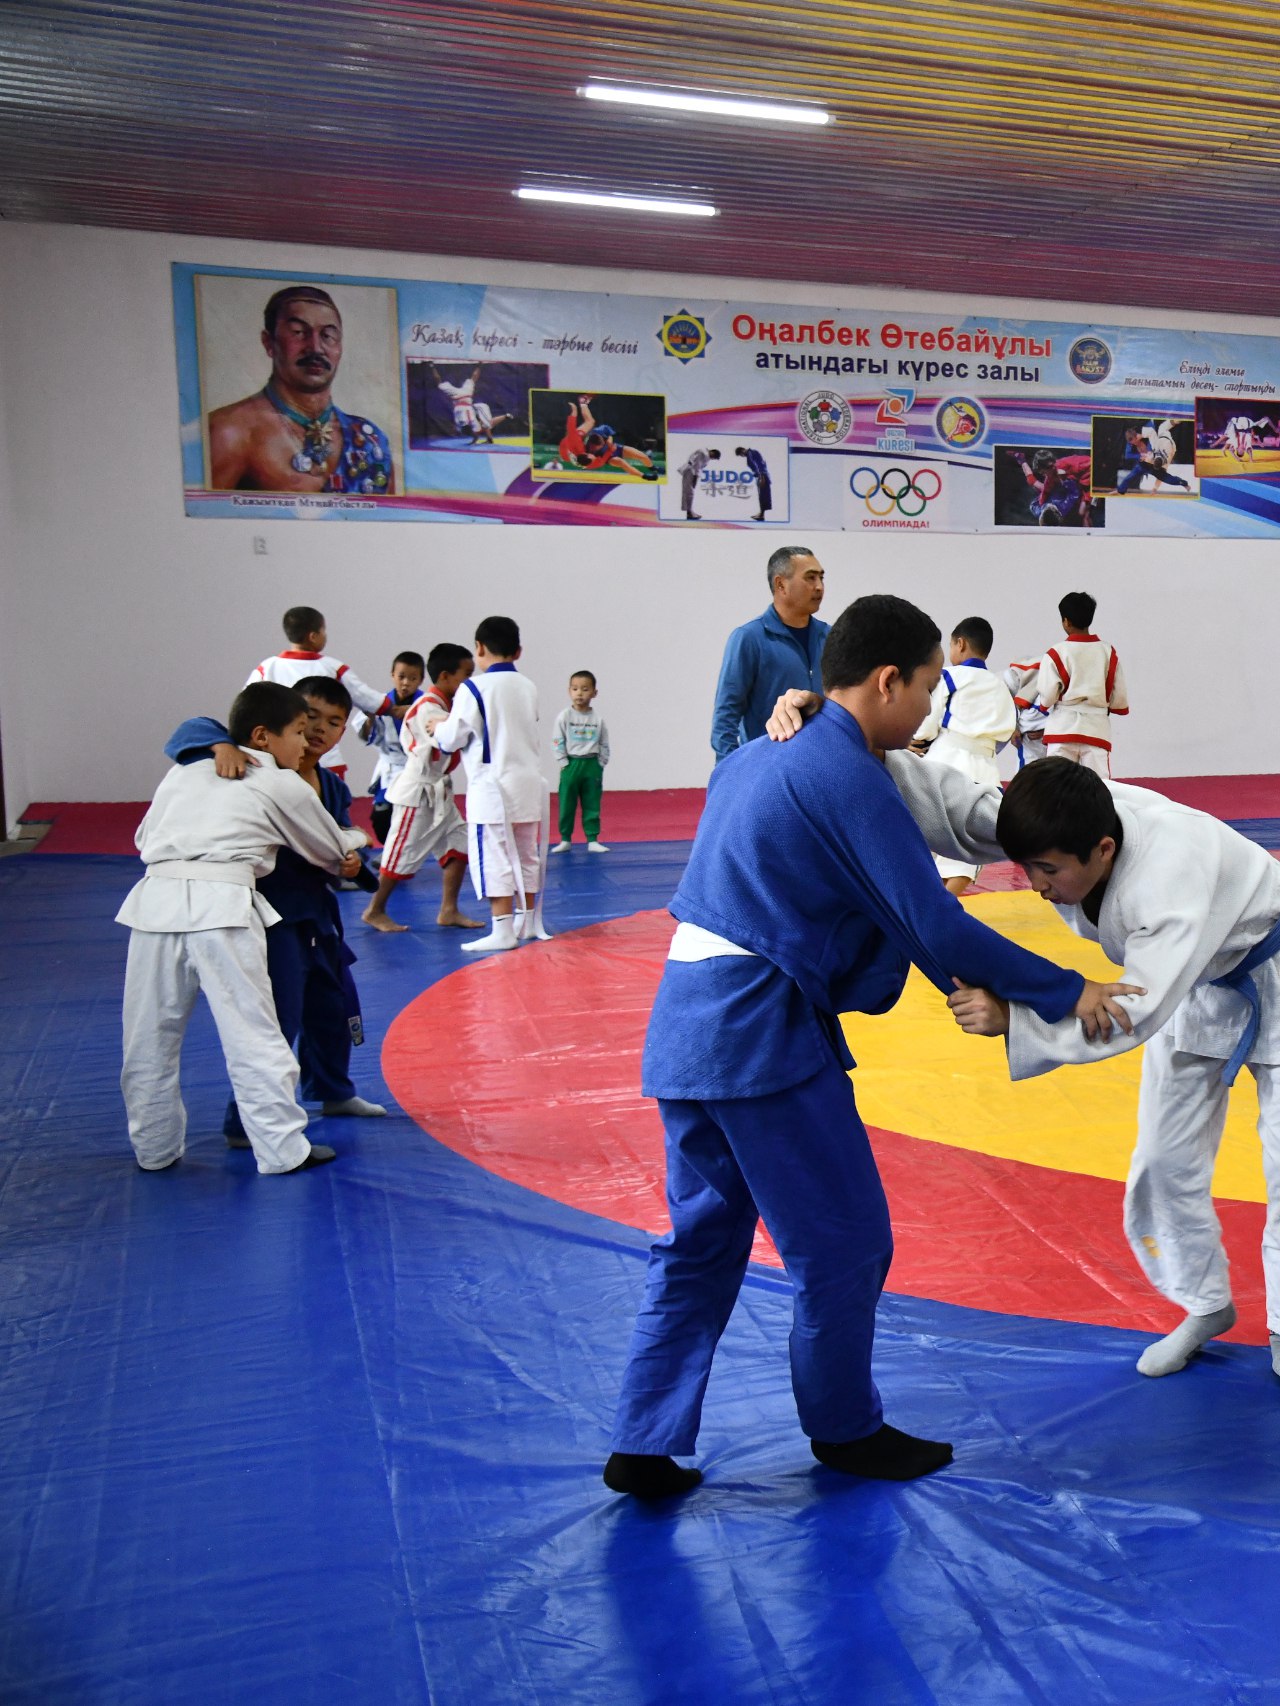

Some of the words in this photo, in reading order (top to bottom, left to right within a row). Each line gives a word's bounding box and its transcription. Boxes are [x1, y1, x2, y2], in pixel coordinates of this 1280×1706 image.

[412, 324, 465, 348] Қазақ
[732, 314, 871, 346] Оңалбек
[880, 323, 1052, 359] Өтебайұлы
[756, 352, 889, 375] атындағы
[898, 359, 969, 382] күрес
[977, 365, 1040, 382] залы
[700, 470, 754, 484] JUDO
[862, 519, 930, 529] ОЛИМПИАДА!
